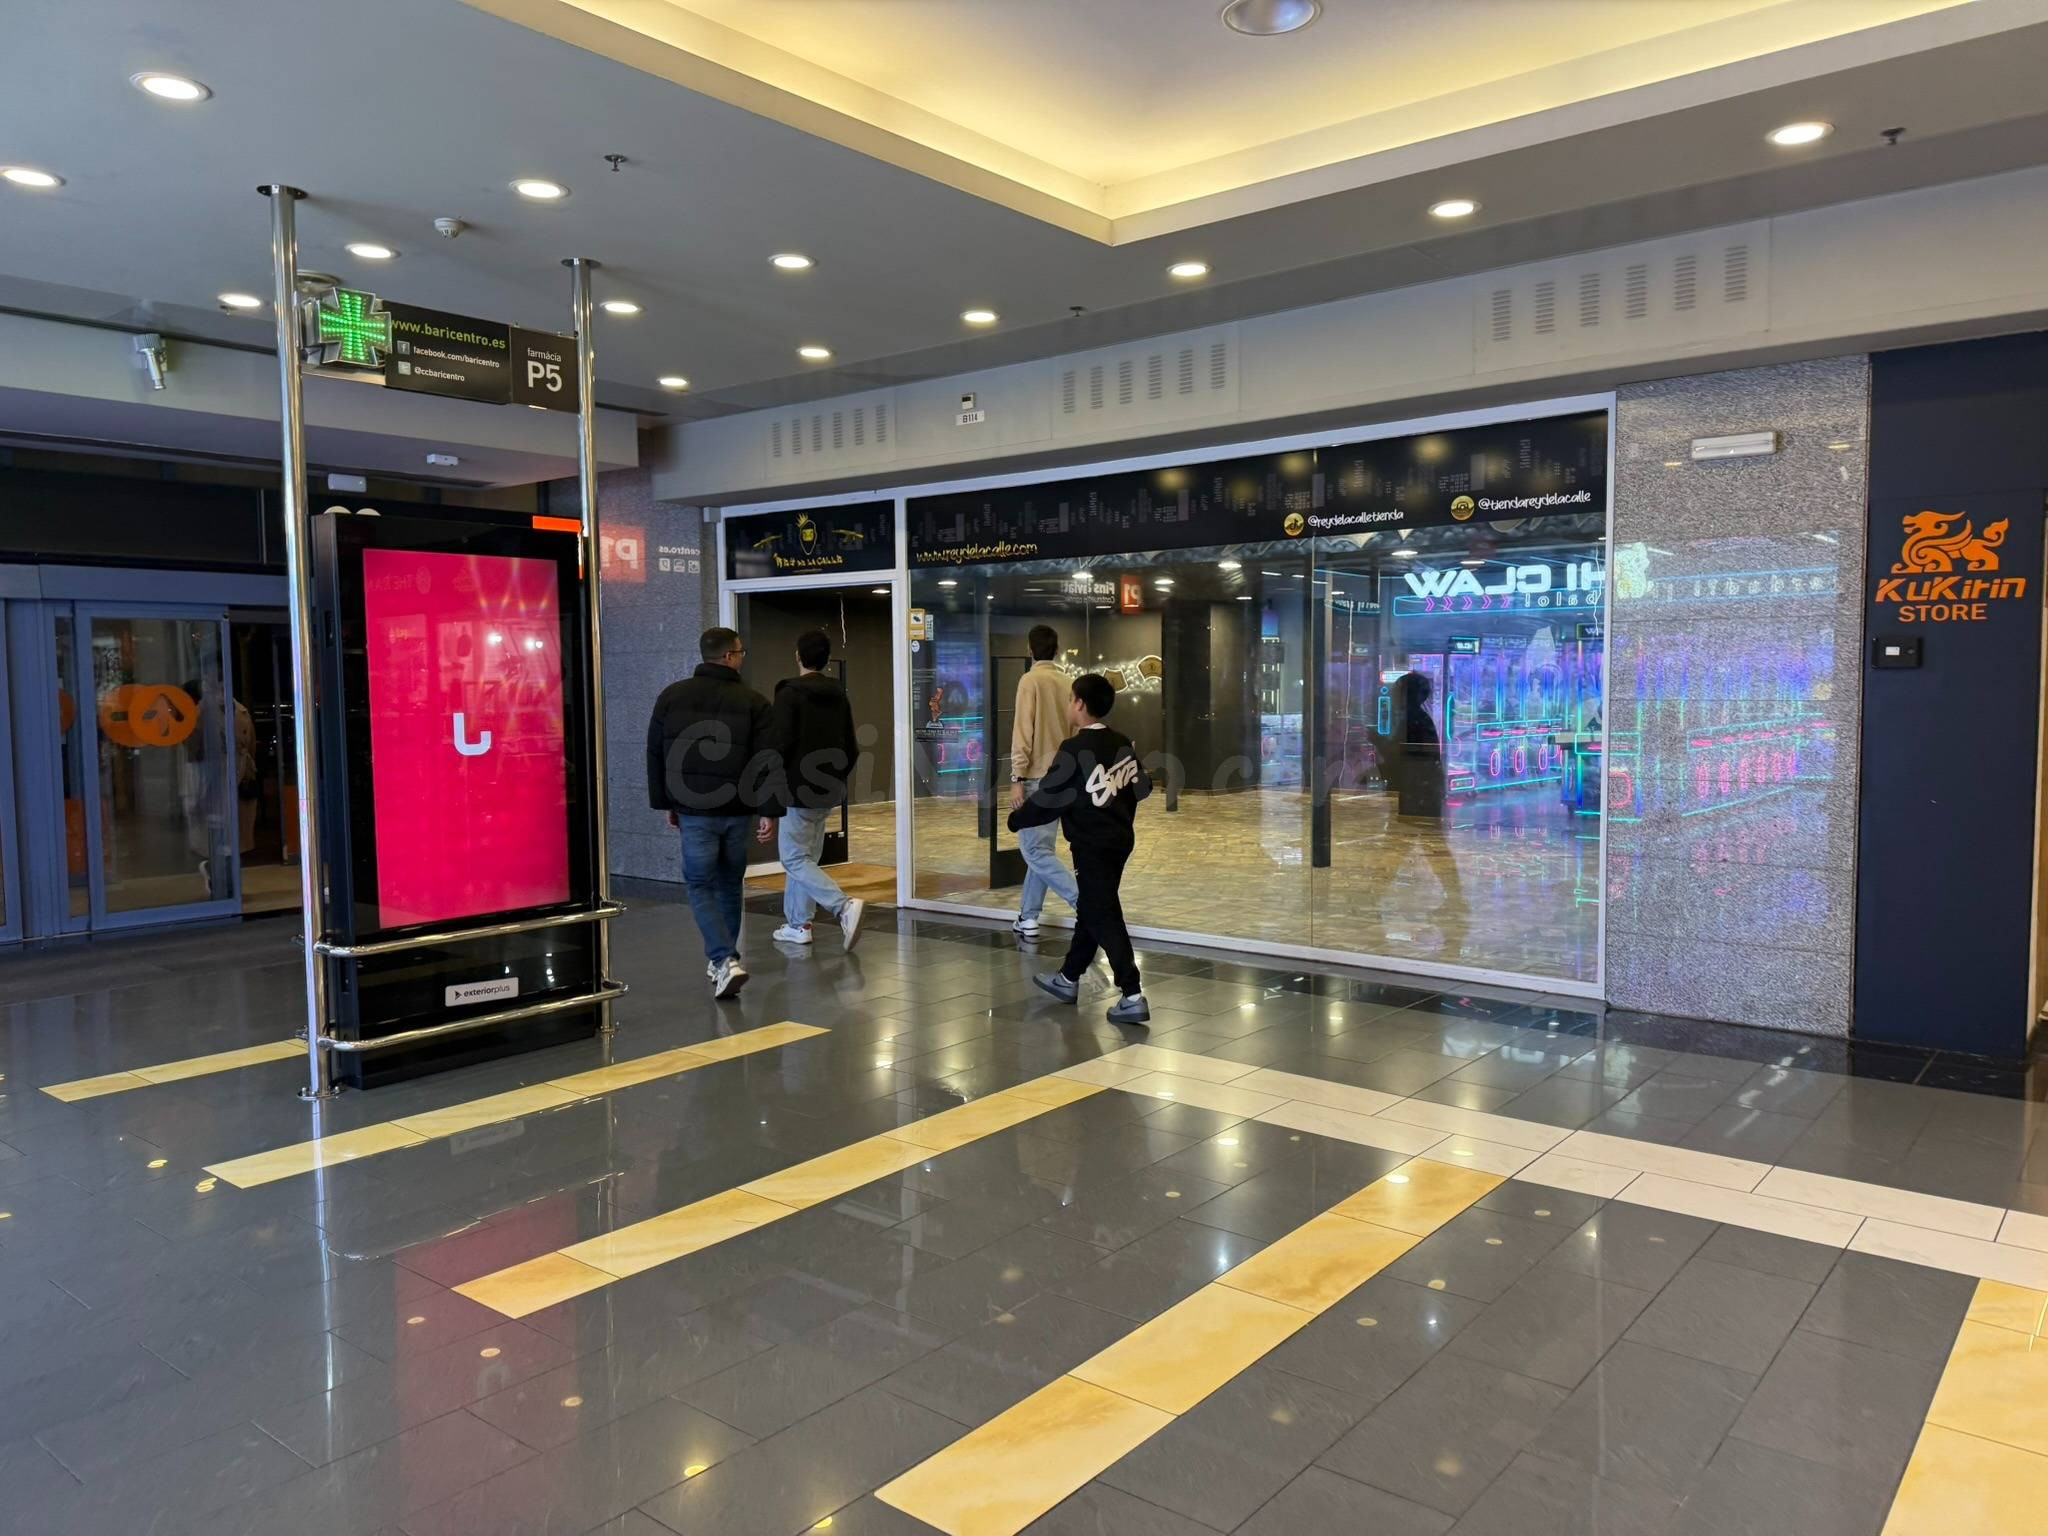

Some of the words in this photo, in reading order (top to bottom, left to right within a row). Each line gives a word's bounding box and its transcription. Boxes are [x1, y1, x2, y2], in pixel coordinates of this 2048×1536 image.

[391, 319, 506, 349] www.baricentro.es
[413, 346, 500, 368] facebook.com/baricentro
[414, 366, 465, 382] @ccbaricentro
[527, 360, 563, 393] P5
[1478, 490, 1591, 511] @tiendareydelacalle
[1307, 509, 1404, 529] @reydelacalletienda
[916, 541, 1039, 564] www.reydelacalle.com
[1875, 576, 2026, 602] KuKirin
[1898, 603, 1988, 623] STORE
[463, 985, 510, 997] exteriorplus
